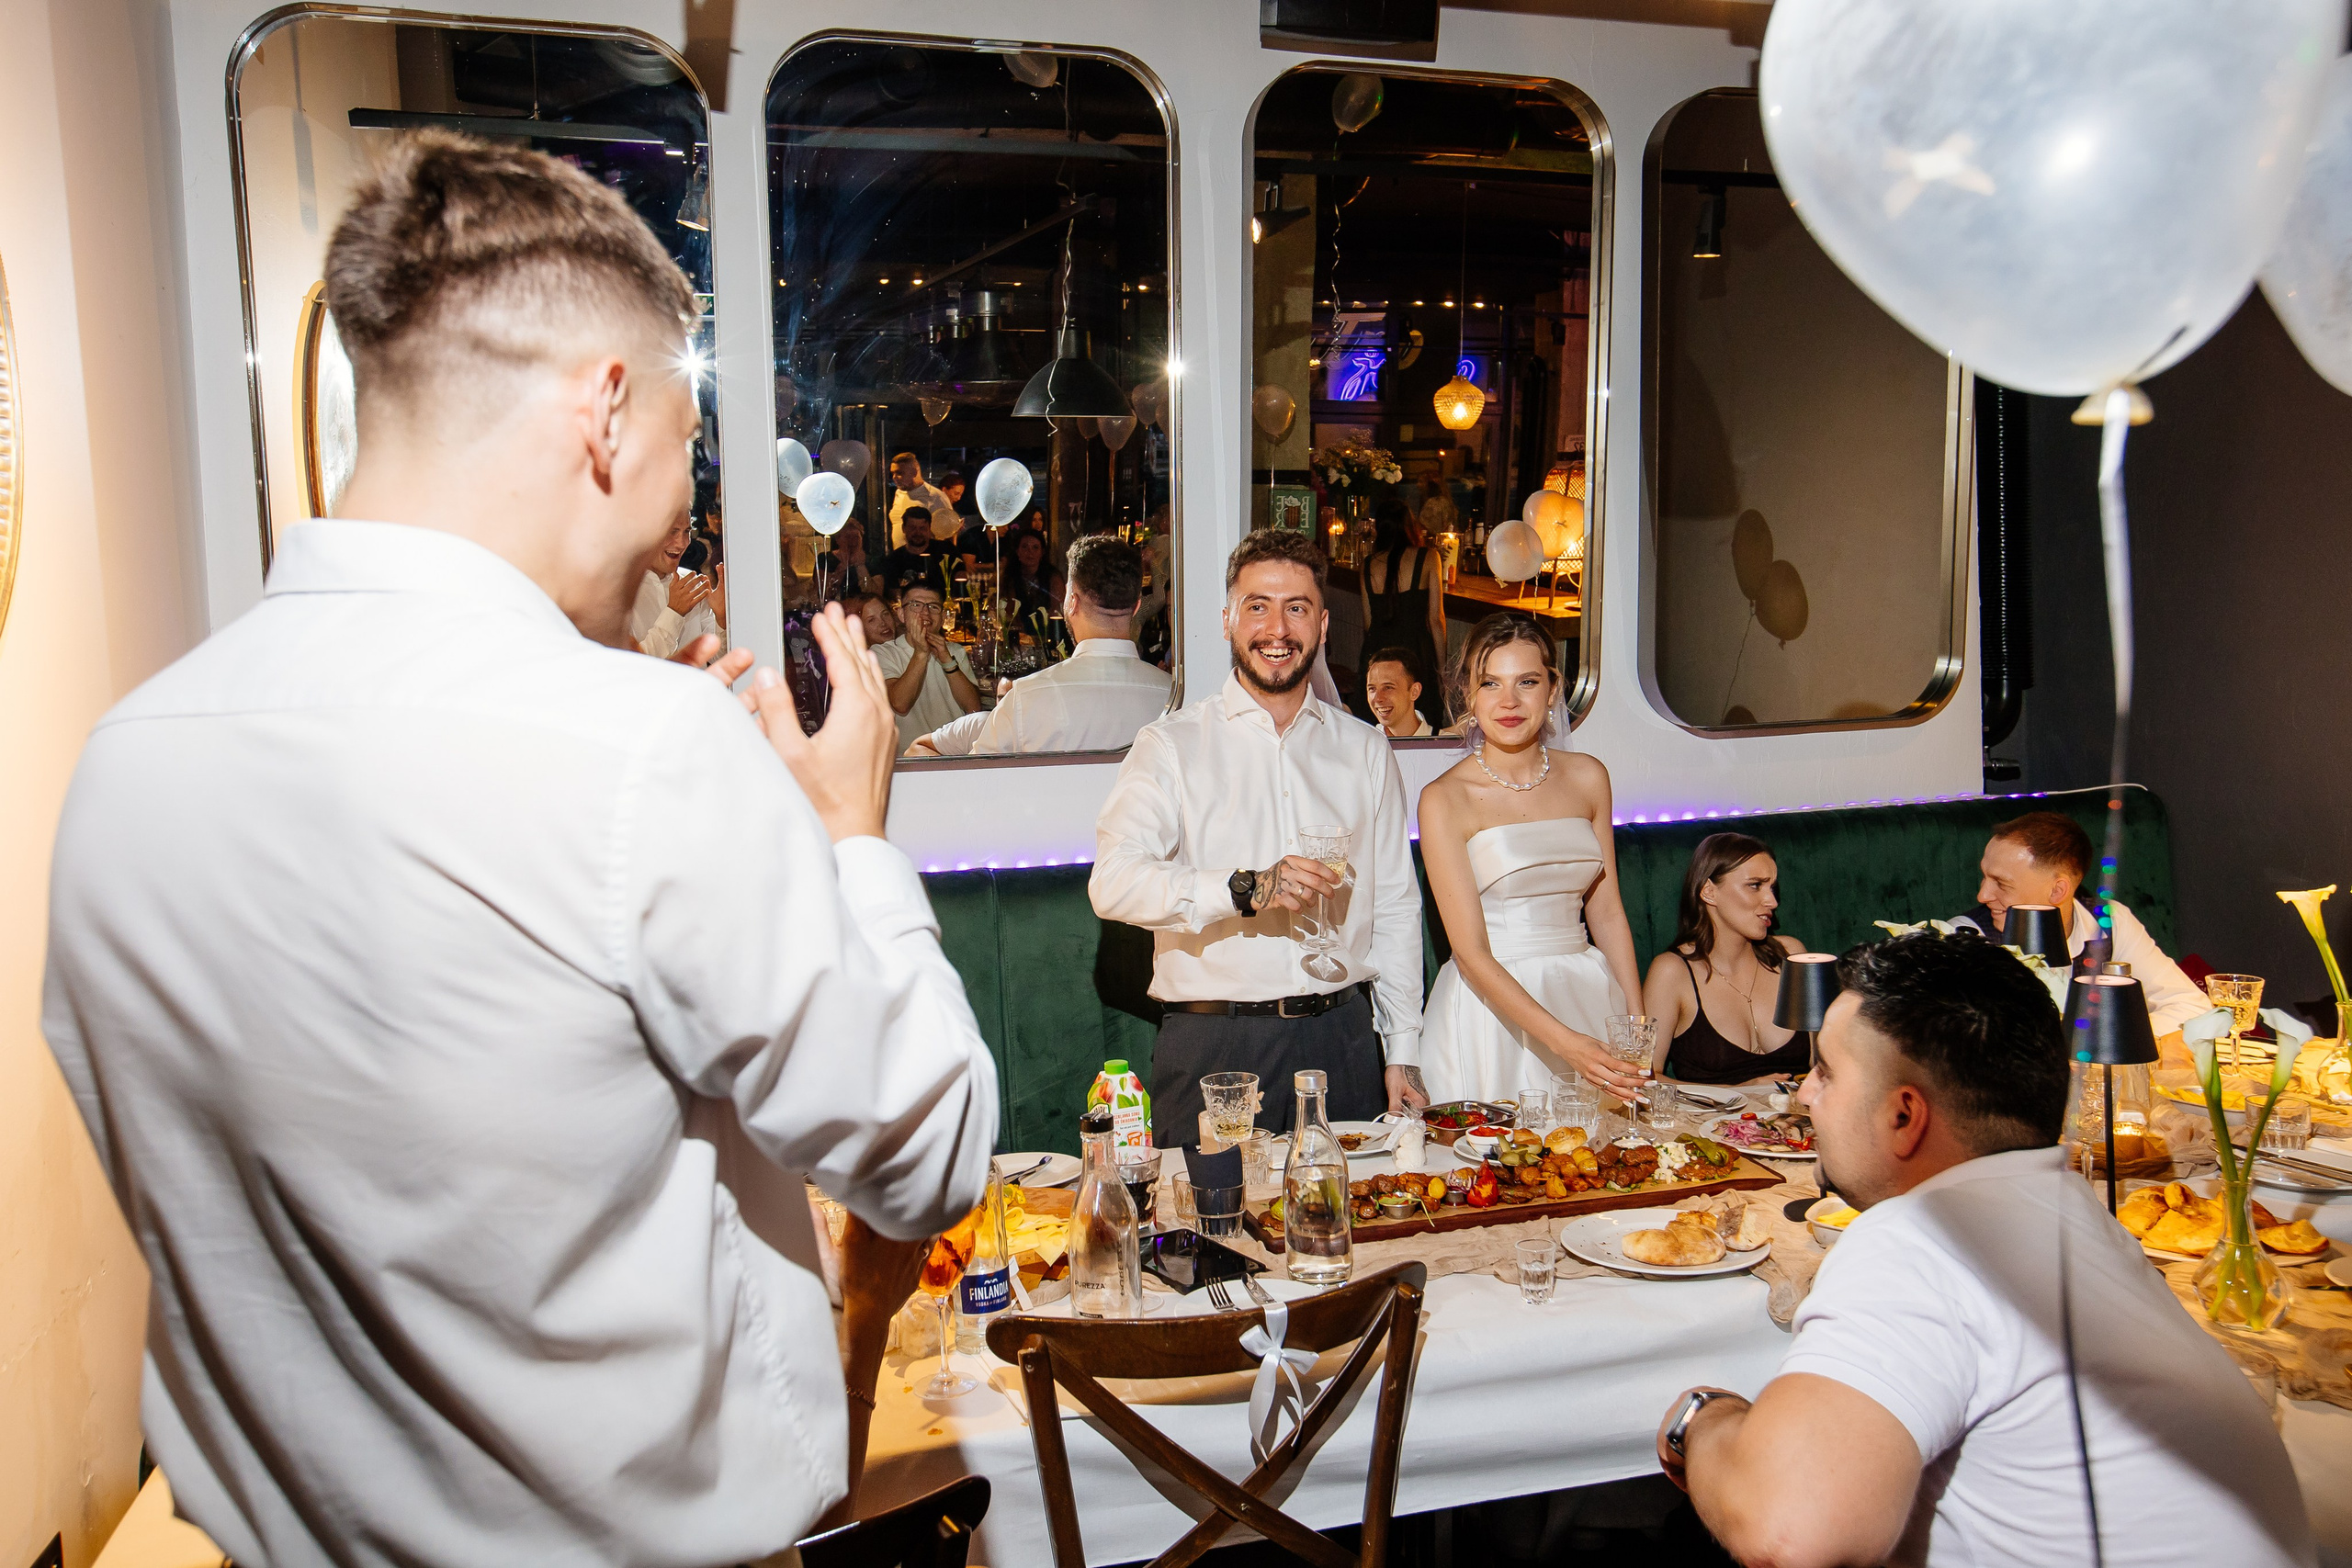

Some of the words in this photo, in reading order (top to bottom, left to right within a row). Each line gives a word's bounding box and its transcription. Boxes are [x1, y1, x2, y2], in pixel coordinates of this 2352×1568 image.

[1074, 1280, 1106, 1290] PUREZZA
[968, 1280, 1009, 1302] FINLANDIA
[993, 1295, 1007, 1304] FINLAND
